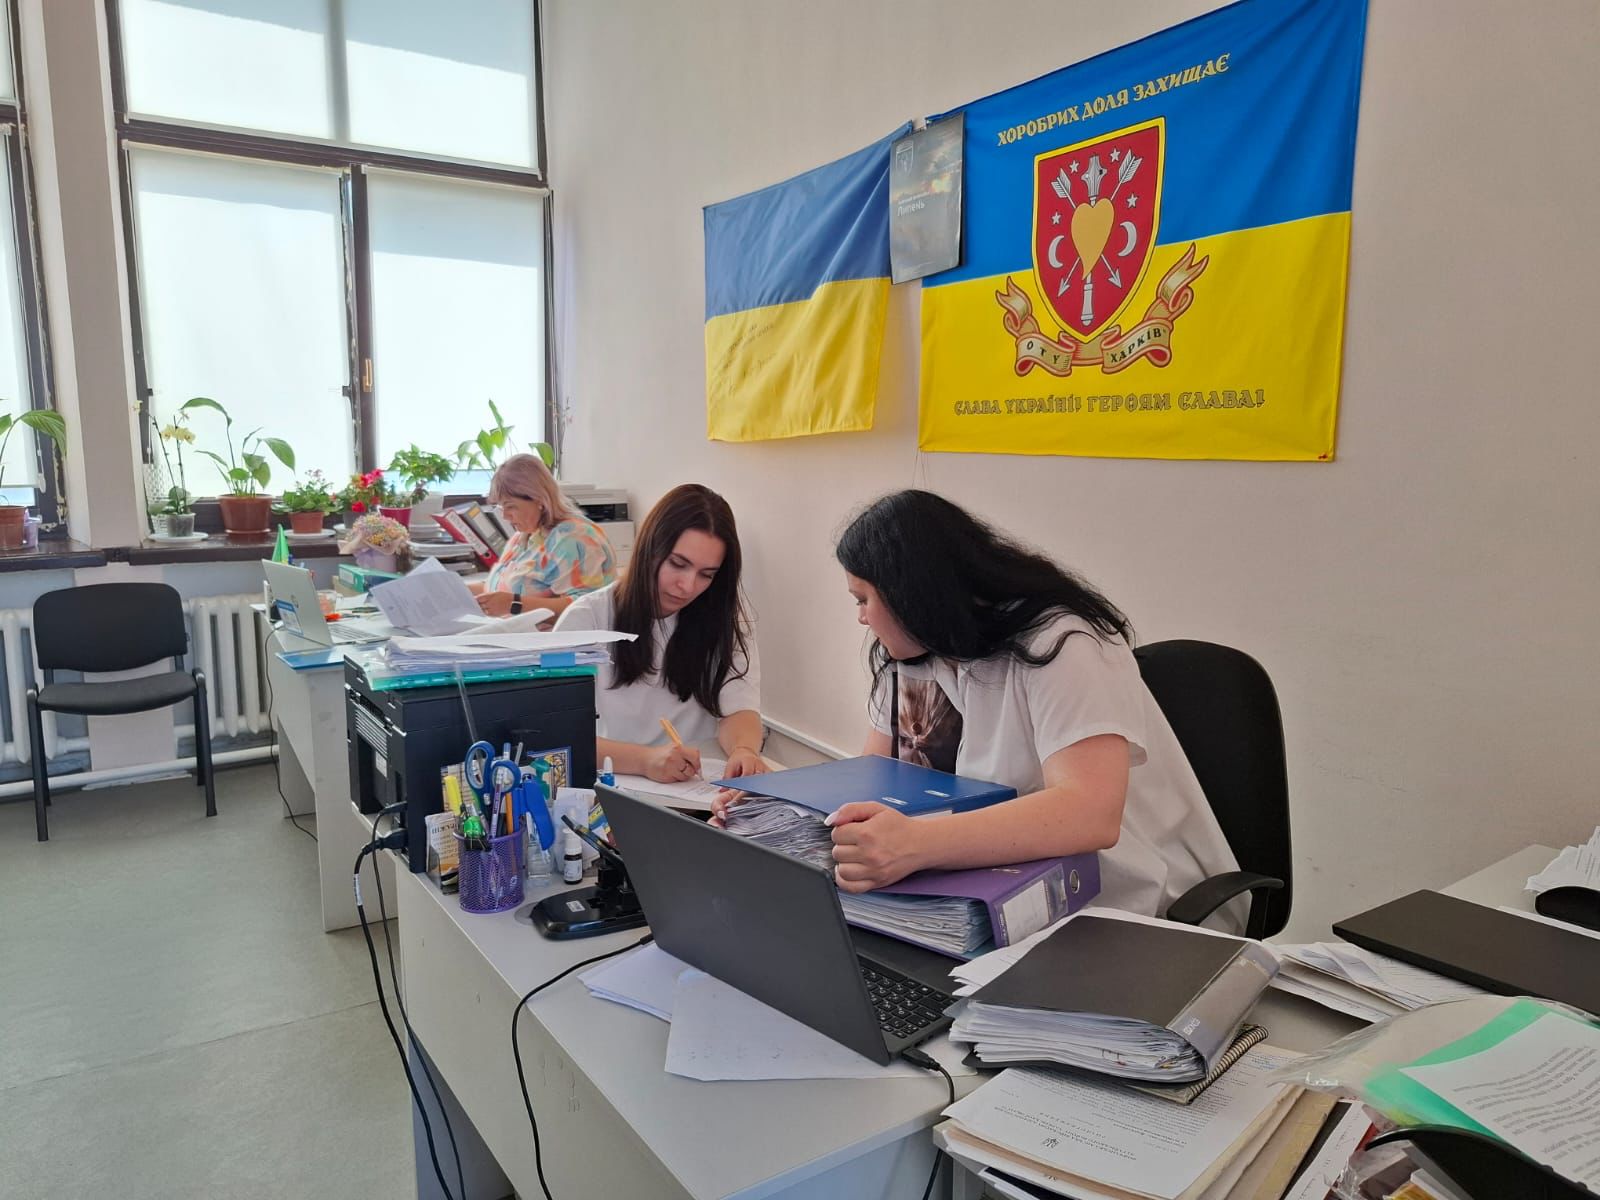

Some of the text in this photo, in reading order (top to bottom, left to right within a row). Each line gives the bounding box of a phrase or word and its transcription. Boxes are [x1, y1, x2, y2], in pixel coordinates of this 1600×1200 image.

[996, 53, 1230, 147] ХОРОБРИХ ДОЛЯ ЗАХИЩАЄ
[1026, 340, 1060, 365] ОТУ
[954, 400, 1002, 416] СЛАВА
[1087, 393, 1171, 413] ГЕРОЯМ
[1177, 389, 1265, 411] СЛАВА!
